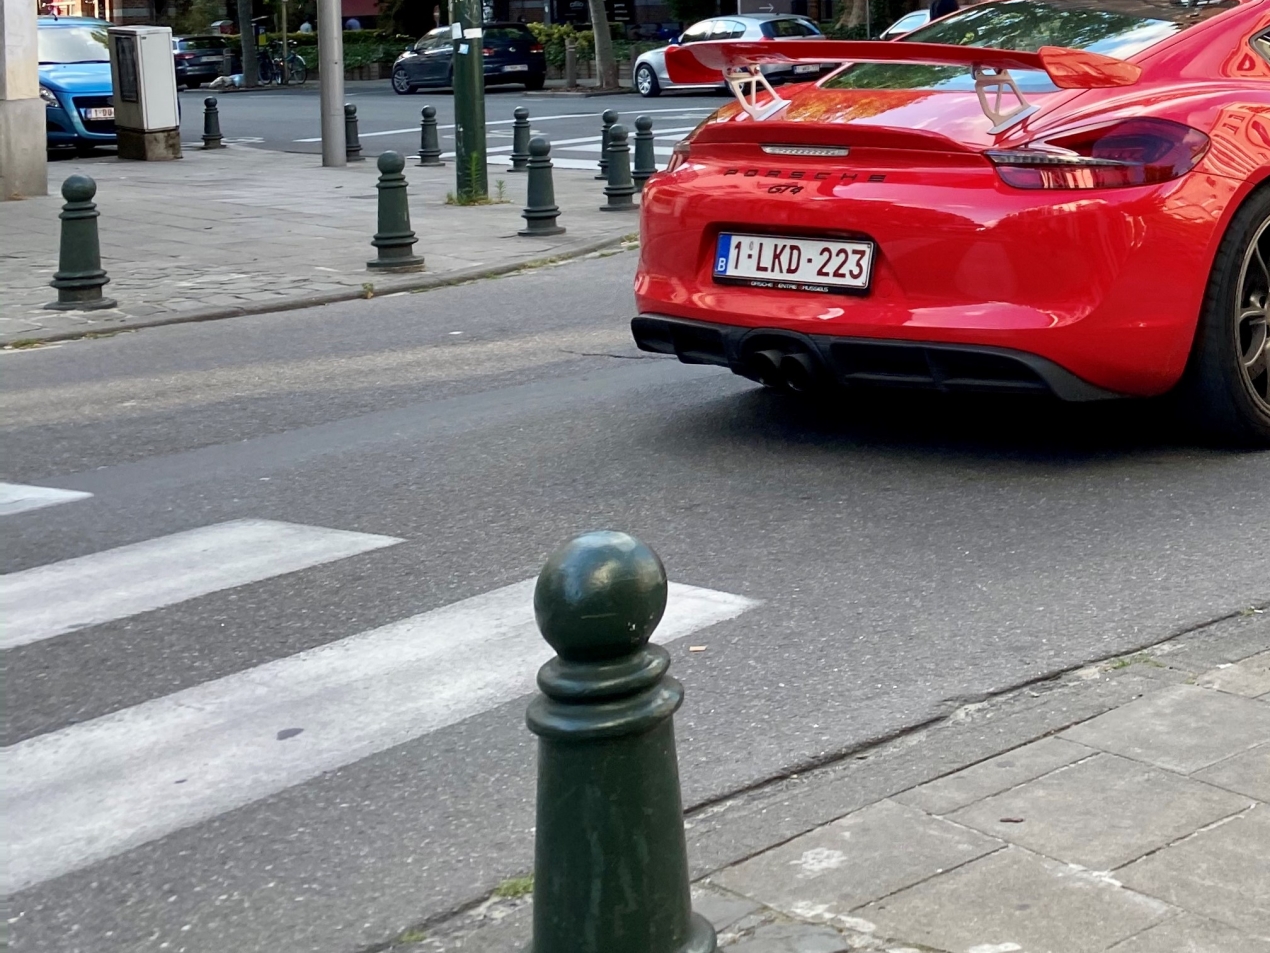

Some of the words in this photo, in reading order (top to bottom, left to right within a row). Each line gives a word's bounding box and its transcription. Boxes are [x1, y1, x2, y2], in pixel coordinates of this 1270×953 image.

[724, 169, 887, 183] PORSCHE
[767, 184, 804, 195] GT4
[717, 257, 727, 272] B
